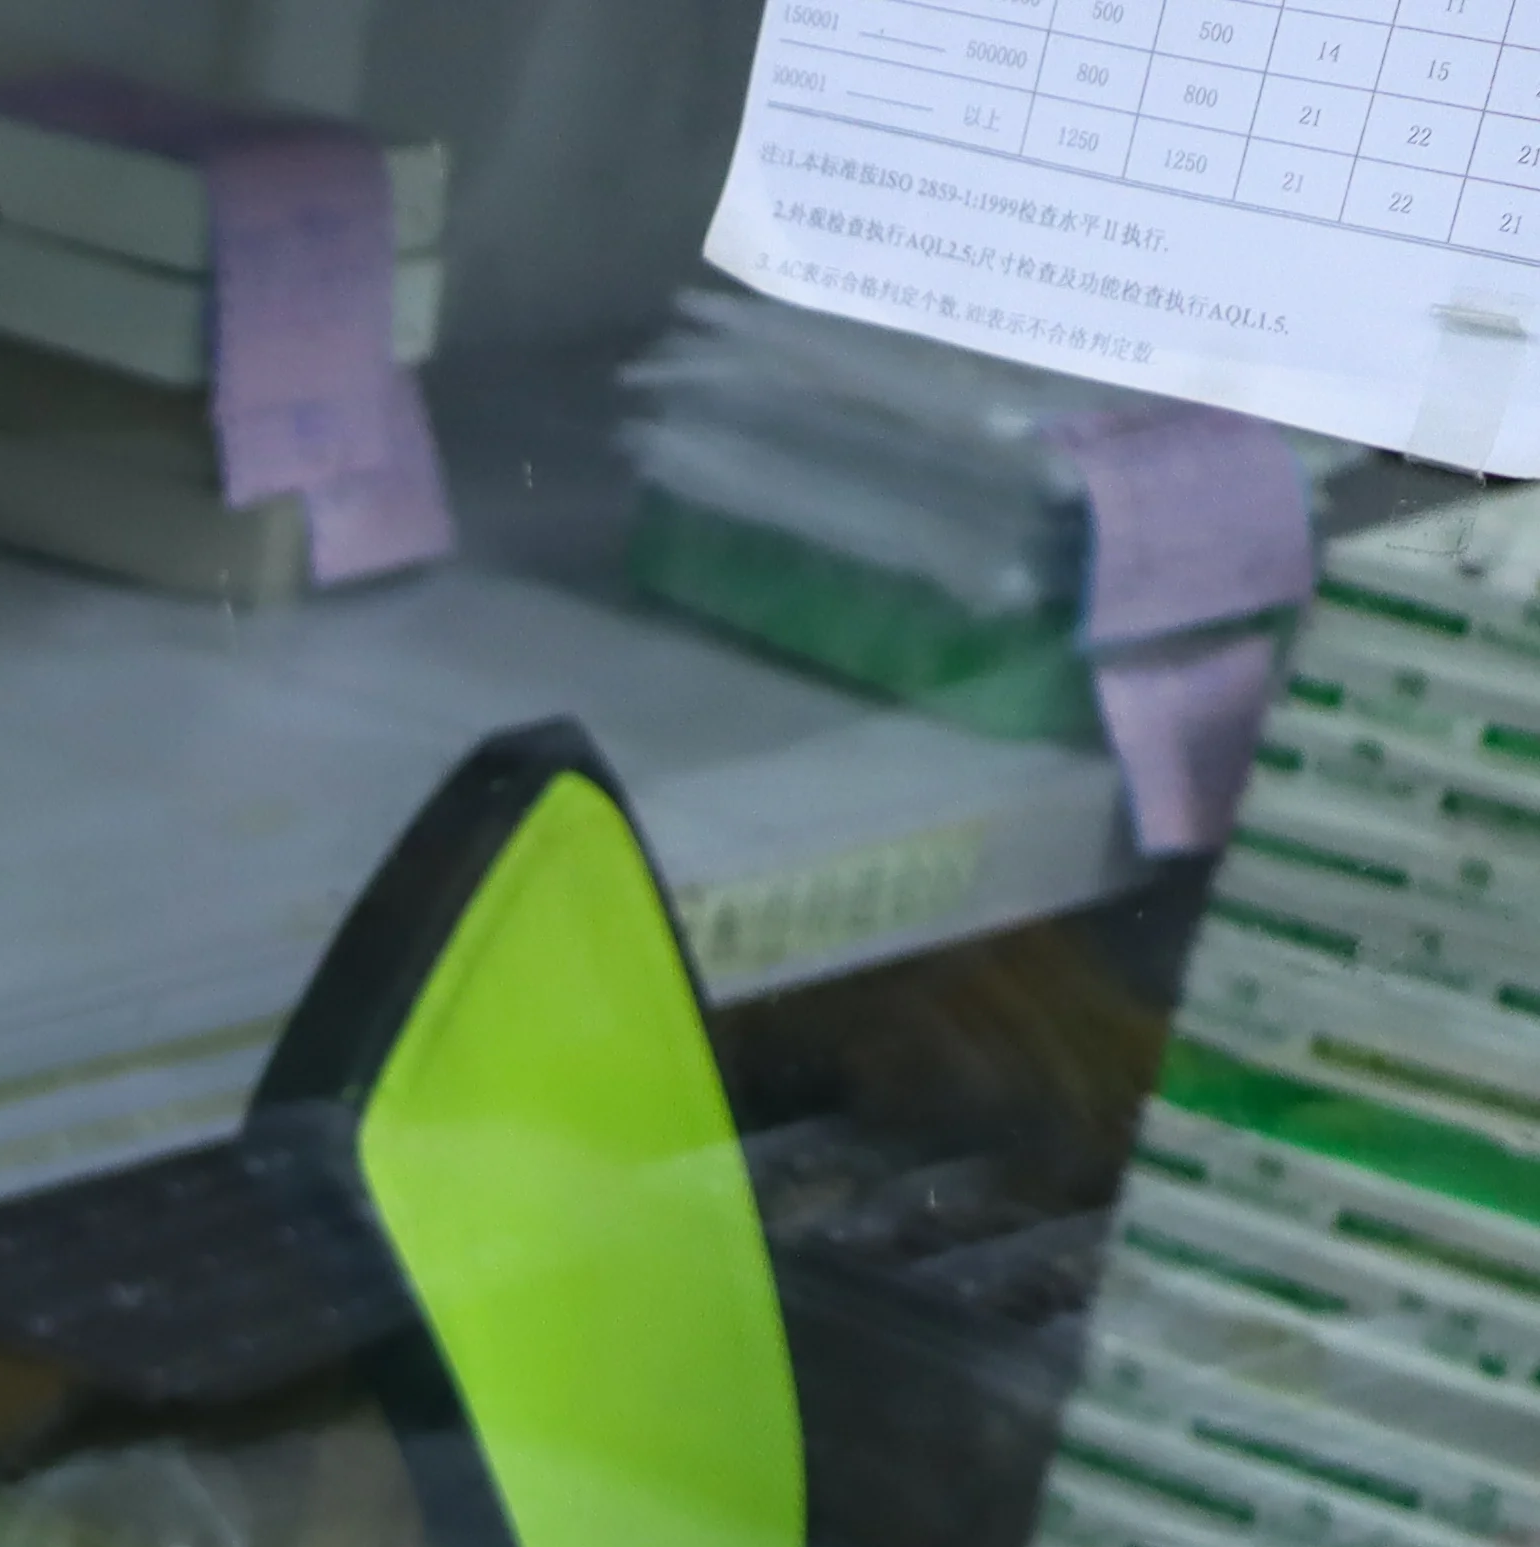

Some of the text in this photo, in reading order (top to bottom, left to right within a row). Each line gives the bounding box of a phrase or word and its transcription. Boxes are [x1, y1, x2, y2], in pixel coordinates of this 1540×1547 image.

[966, 39, 1028, 69] 500000
[1076, 62, 1110, 87] 800
[1182, 83, 1218, 109] 800
[1298, 105, 1322, 128] 21
[1406, 124, 1433, 148] 22
[1092, 1, 1452, 82] 500 500 14 15
[963, 104, 1002, 132] 以上
[1057, 125, 1100, 152] 1250
[1163, 147, 1209, 175] 1250
[1281, 171, 1305, 194] 21
[1388, 191, 1415, 215] 22
[1499, 212, 1523, 235] 21
